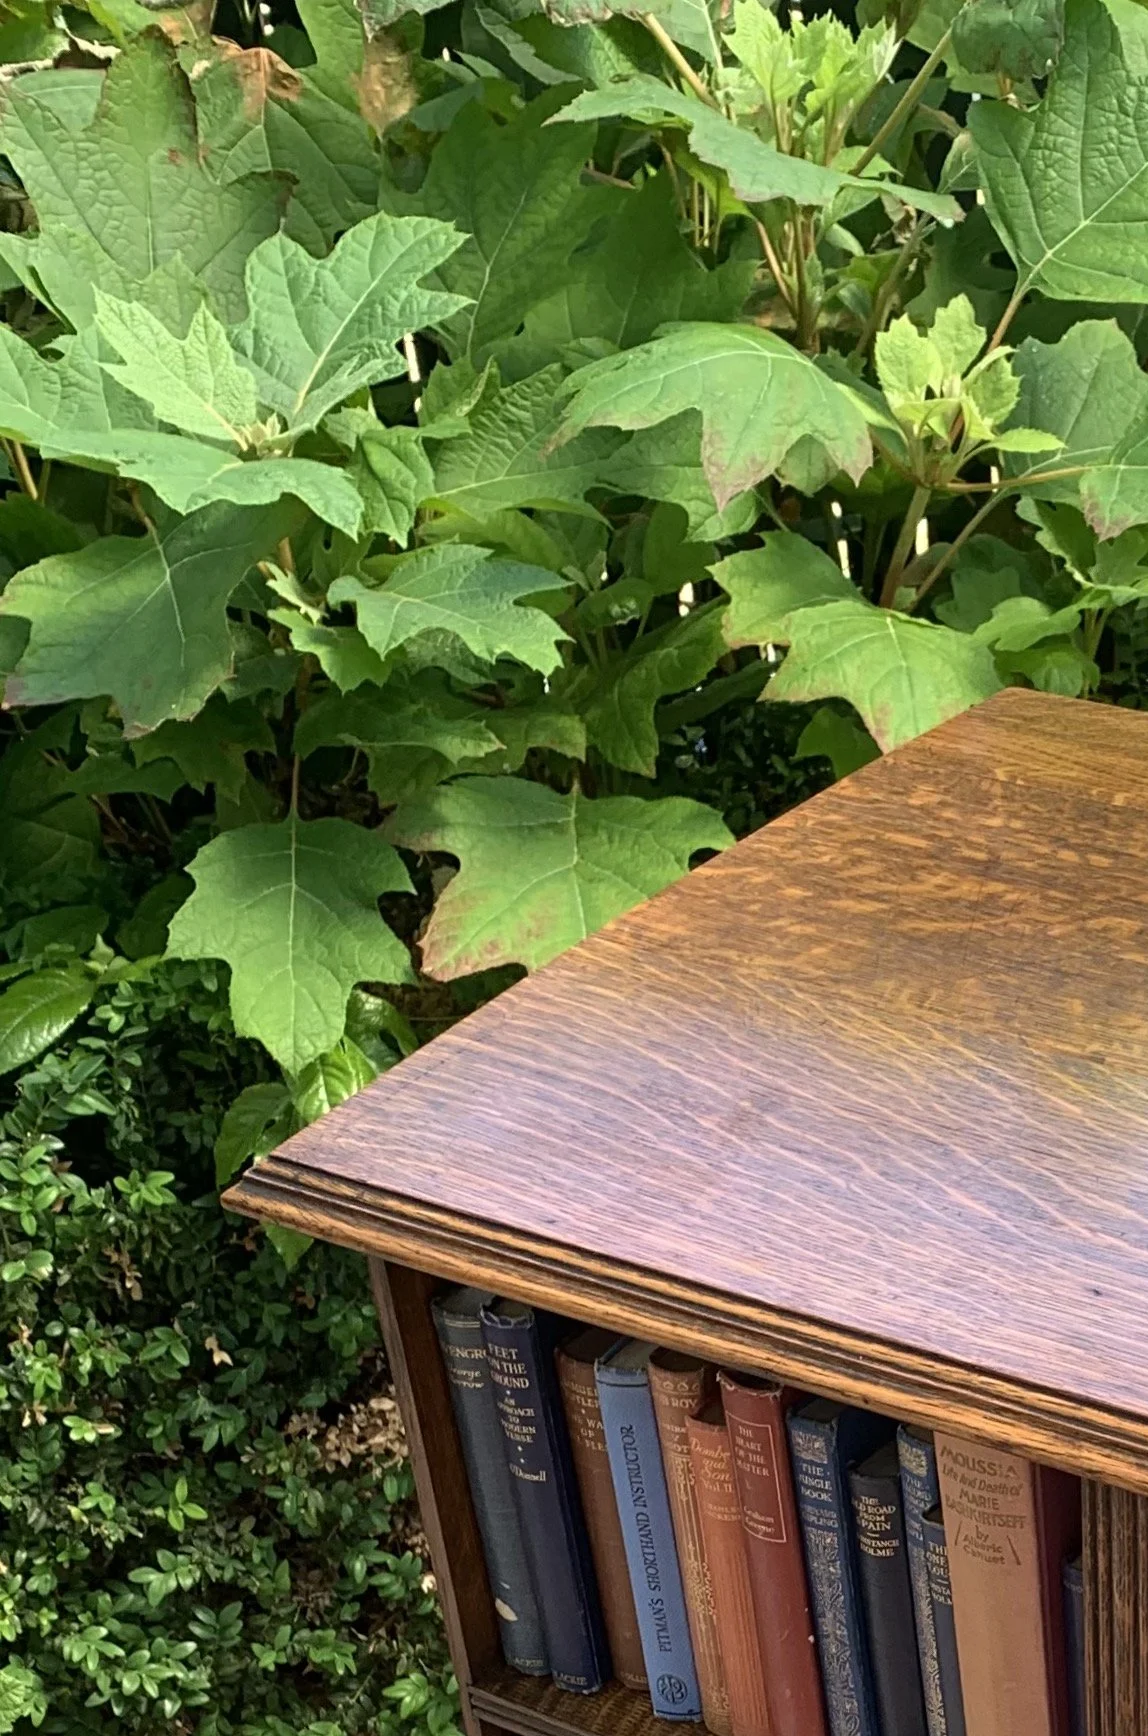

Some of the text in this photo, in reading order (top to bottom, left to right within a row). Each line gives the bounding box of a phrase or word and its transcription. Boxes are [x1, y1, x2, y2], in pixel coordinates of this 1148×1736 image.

[487, 1343, 518, 1360] FEET
[502, 1361, 527, 1374] THE
[748, 1453, 765, 1465] THE
[702, 1467, 731, 1481] Son
[802, 1463, 824, 1476] THE
[979, 1478, 1009, 1495] Death
[959, 1488, 999, 1511] MARIE
[867, 1504, 896, 1515] ROAD
[620, 1423, 672, 1653] PITMAN'S SHORTHAND INSTRUCTOR
